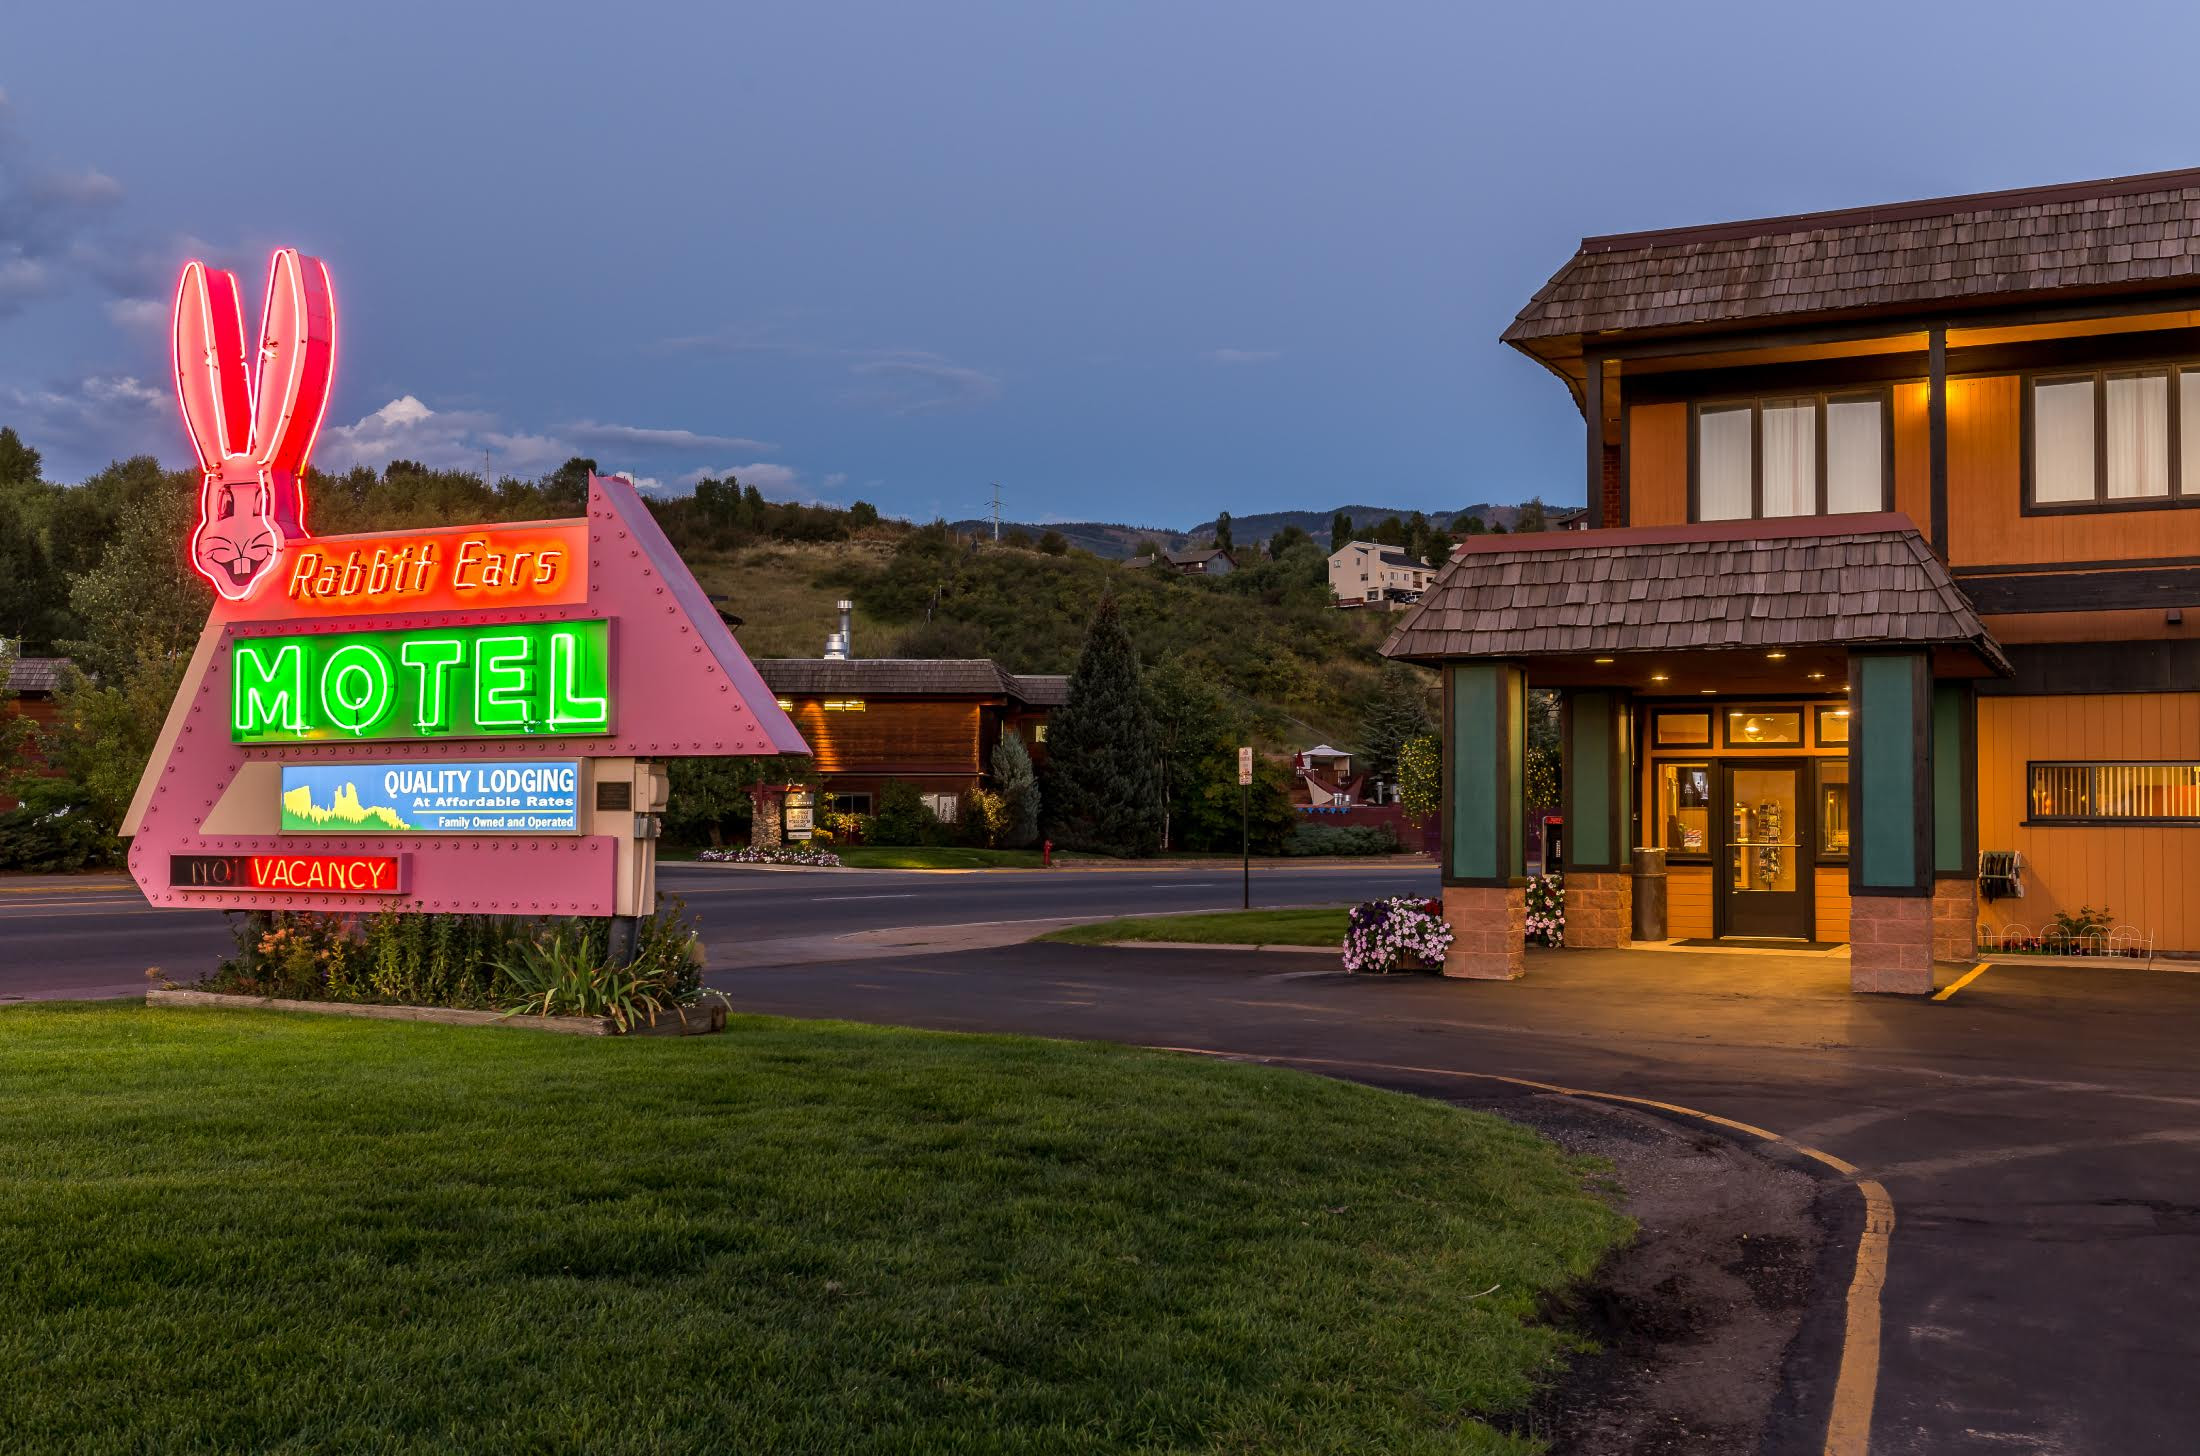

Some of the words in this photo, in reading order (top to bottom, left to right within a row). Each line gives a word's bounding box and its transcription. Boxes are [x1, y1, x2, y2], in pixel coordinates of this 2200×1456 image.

[289, 545, 438, 599] Rabbit
[453, 540, 561, 590] Ears
[235, 633, 607, 733] MOTEL
[384, 770, 471, 798] QUALITY
[478, 768, 574, 793] LODGING
[412, 796, 430, 807] At
[436, 796, 520, 807] Affordable
[526, 796, 574, 807] Rates
[438, 817, 470, 828] Family
[472, 816, 504, 827] Owned
[507, 816, 524, 827] and
[527, 816, 574, 828] Operated
[192, 861, 231, 884] NO
[254, 858, 387, 889] VACANCY
